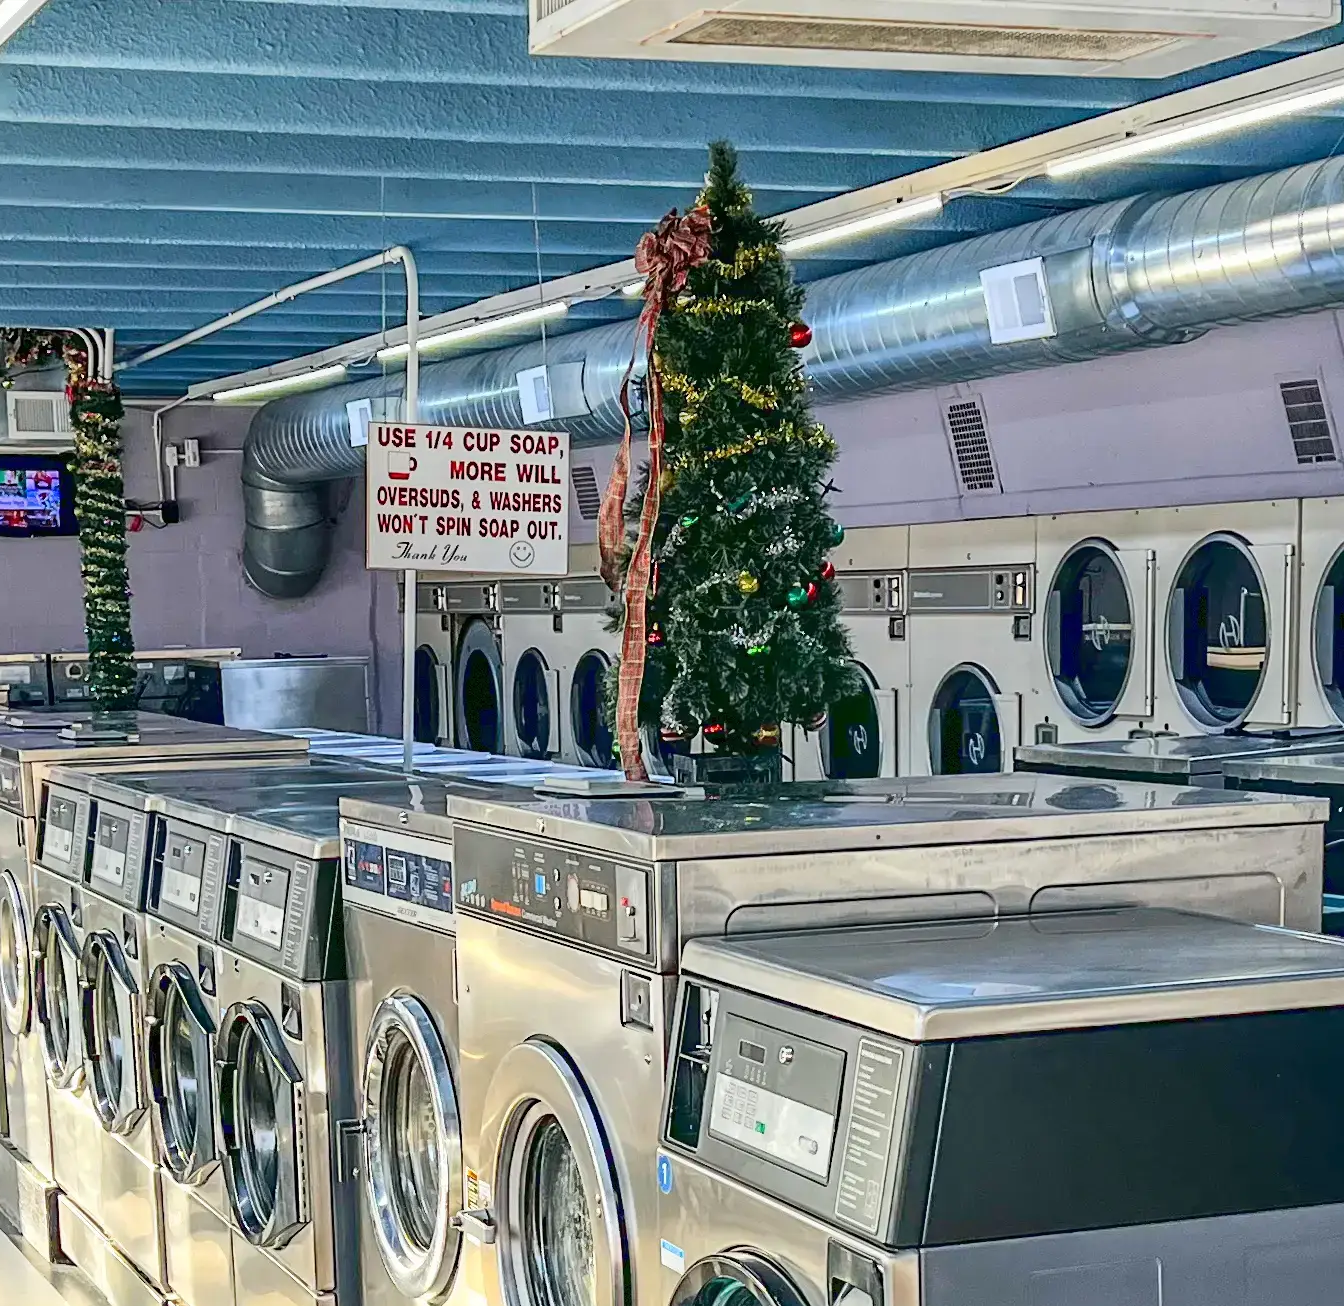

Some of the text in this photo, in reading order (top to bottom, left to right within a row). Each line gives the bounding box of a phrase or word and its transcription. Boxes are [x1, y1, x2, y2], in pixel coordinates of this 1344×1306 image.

[377, 426, 564, 459] USE 1/4 CUP SOAP,
[450, 461, 561, 485] MORE WILL
[377, 486, 562, 514] OVERSUDS, & WASHERS
[377, 513, 562, 541] WON'T SPIN SOAP OUT.
[392, 541, 468, 566] Thank You
[661, 1162, 668, 1185] 1
